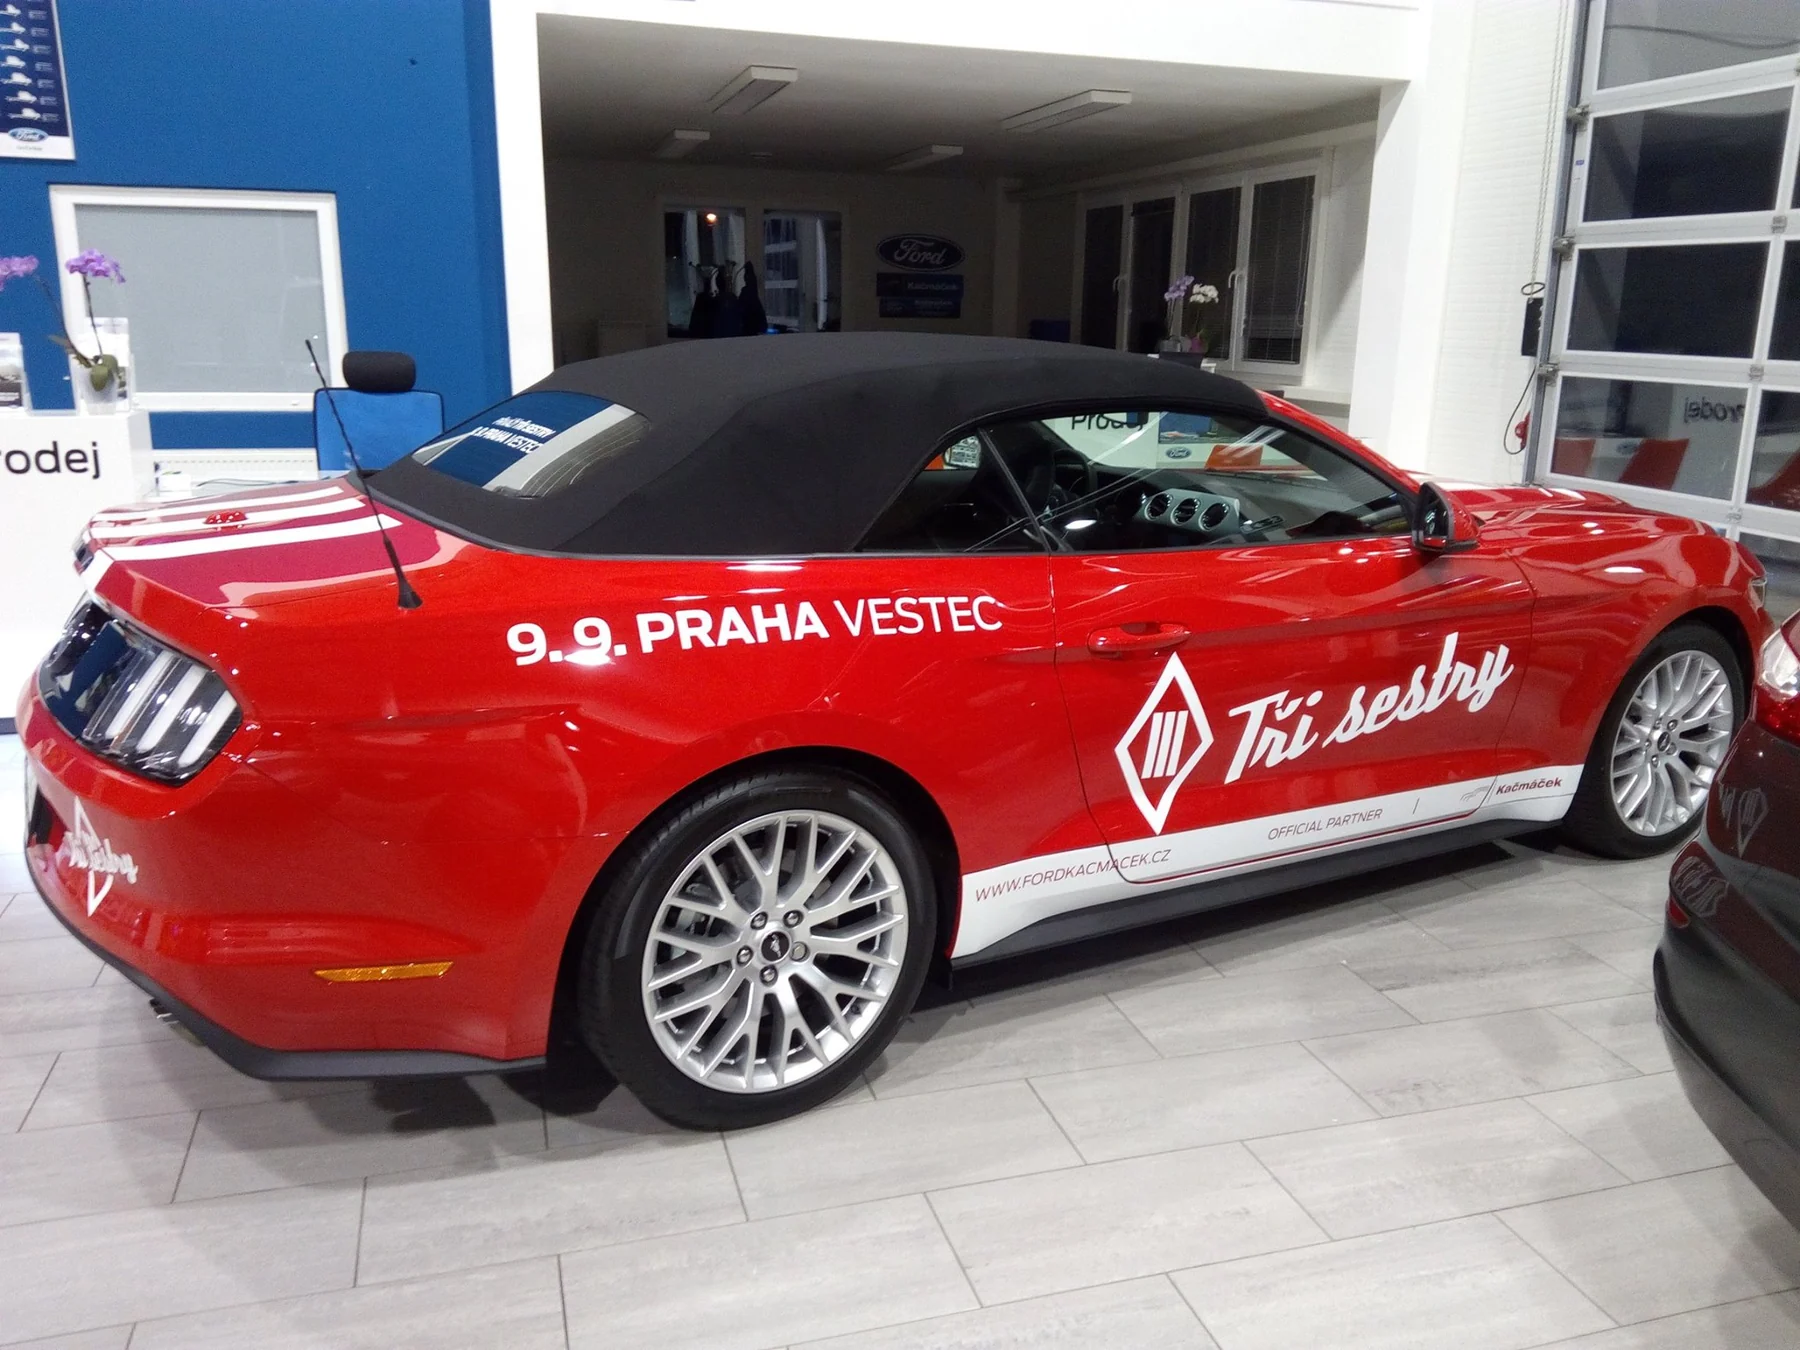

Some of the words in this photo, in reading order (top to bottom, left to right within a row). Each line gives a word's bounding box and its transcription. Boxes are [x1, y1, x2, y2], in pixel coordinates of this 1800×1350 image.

[894, 239, 948, 265] Ford
[0, 440, 100, 480] odej
[506, 616, 627, 666] 9.9.
[636, 601, 830, 653] PRAHA
[833, 596, 1003, 637] VESTEC
[1224, 689, 1323, 785] Tři
[1321, 631, 1515, 749] sestry
[1496, 777, 1563, 795] Kačmáček
[1267, 815, 1322, 841] OFFICIAL
[1325, 808, 1383, 830] PARTNER
[975, 849, 1172, 902] WWW.FORDKACMACEK.CZ
